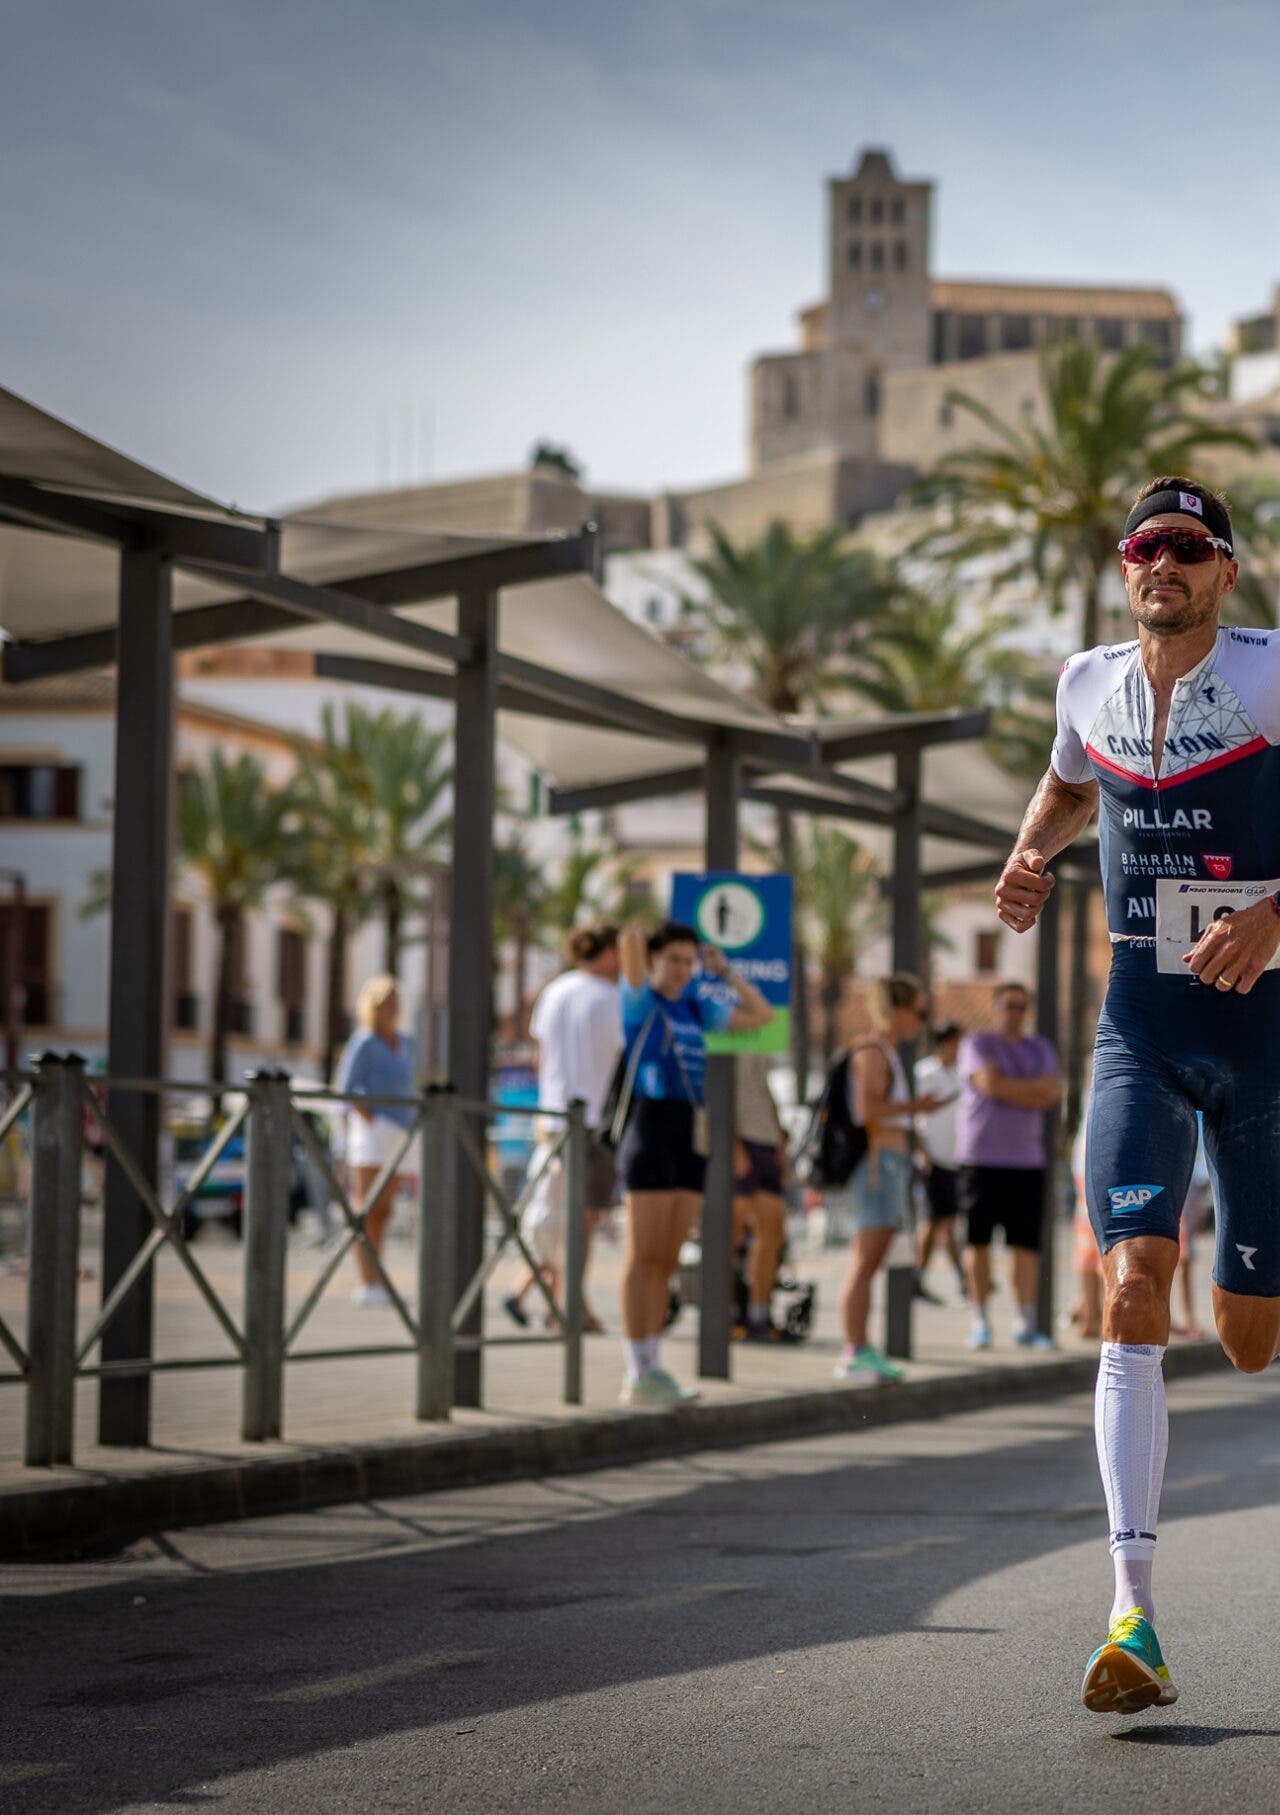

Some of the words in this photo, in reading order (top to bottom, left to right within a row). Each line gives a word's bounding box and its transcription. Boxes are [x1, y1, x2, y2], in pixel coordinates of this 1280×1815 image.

[1230, 632, 1269, 646] CANYON
[1122, 807, 1214, 830] PILLAR
[1121, 852, 1196, 867] BAHRAIN
[1122, 865, 1197, 877] VICTORIOUS
[1110, 1189, 1152, 1210] SAP
